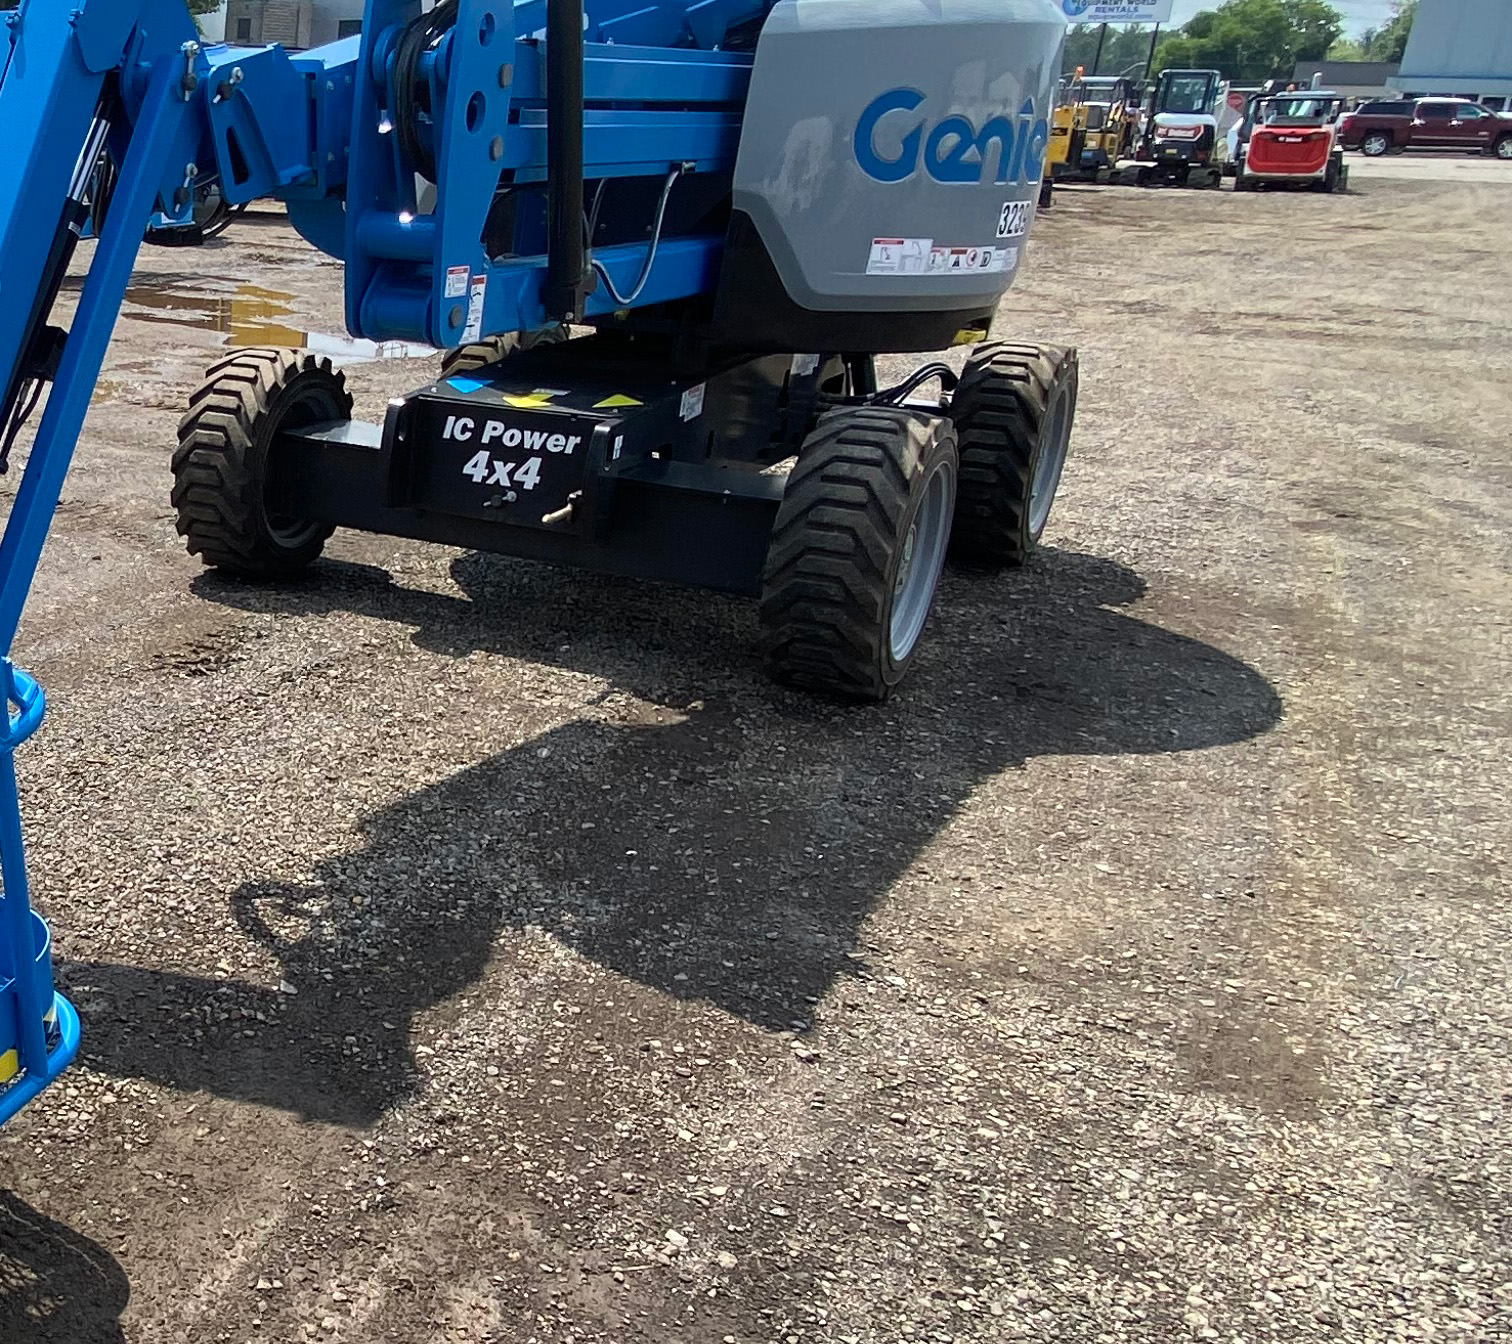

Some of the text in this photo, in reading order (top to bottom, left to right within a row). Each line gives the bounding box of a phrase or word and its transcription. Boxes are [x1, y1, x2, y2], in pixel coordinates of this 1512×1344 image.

[853, 86, 1048, 185] Genie
[442, 415, 475, 441] IC
[481, 420, 582, 454] Power
[462, 450, 543, 490] 4x4
